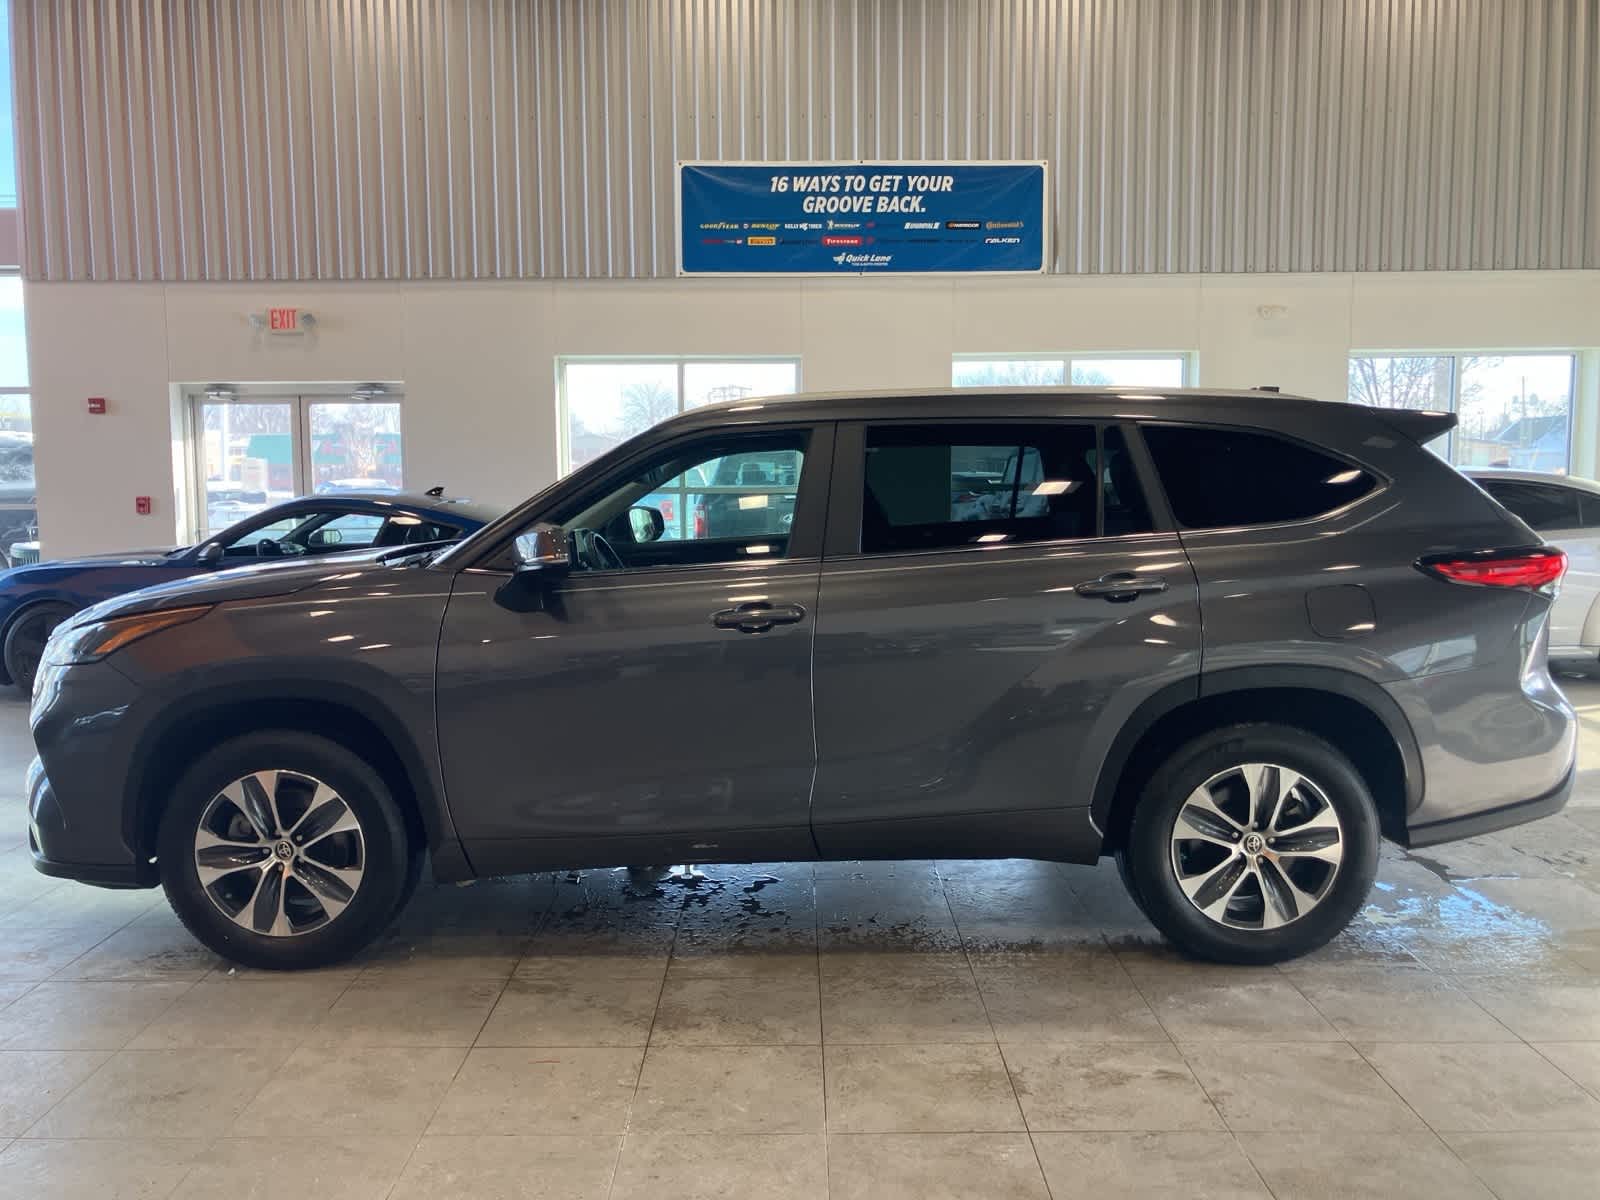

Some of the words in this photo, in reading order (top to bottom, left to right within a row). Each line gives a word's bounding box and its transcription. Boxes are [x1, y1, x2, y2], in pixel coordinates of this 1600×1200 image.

[770, 176, 789, 193] 16
[792, 176, 841, 193] WAYS
[844, 175, 866, 192] TO
[869, 175, 903, 192] GET
[906, 175, 954, 192] YOUR
[802, 196, 874, 213] GROOVE
[876, 195, 927, 213] BACK.
[846, 254, 870, 263] Quick
[871, 254, 892, 262] Lane
[271, 308, 296, 329] EXIT
